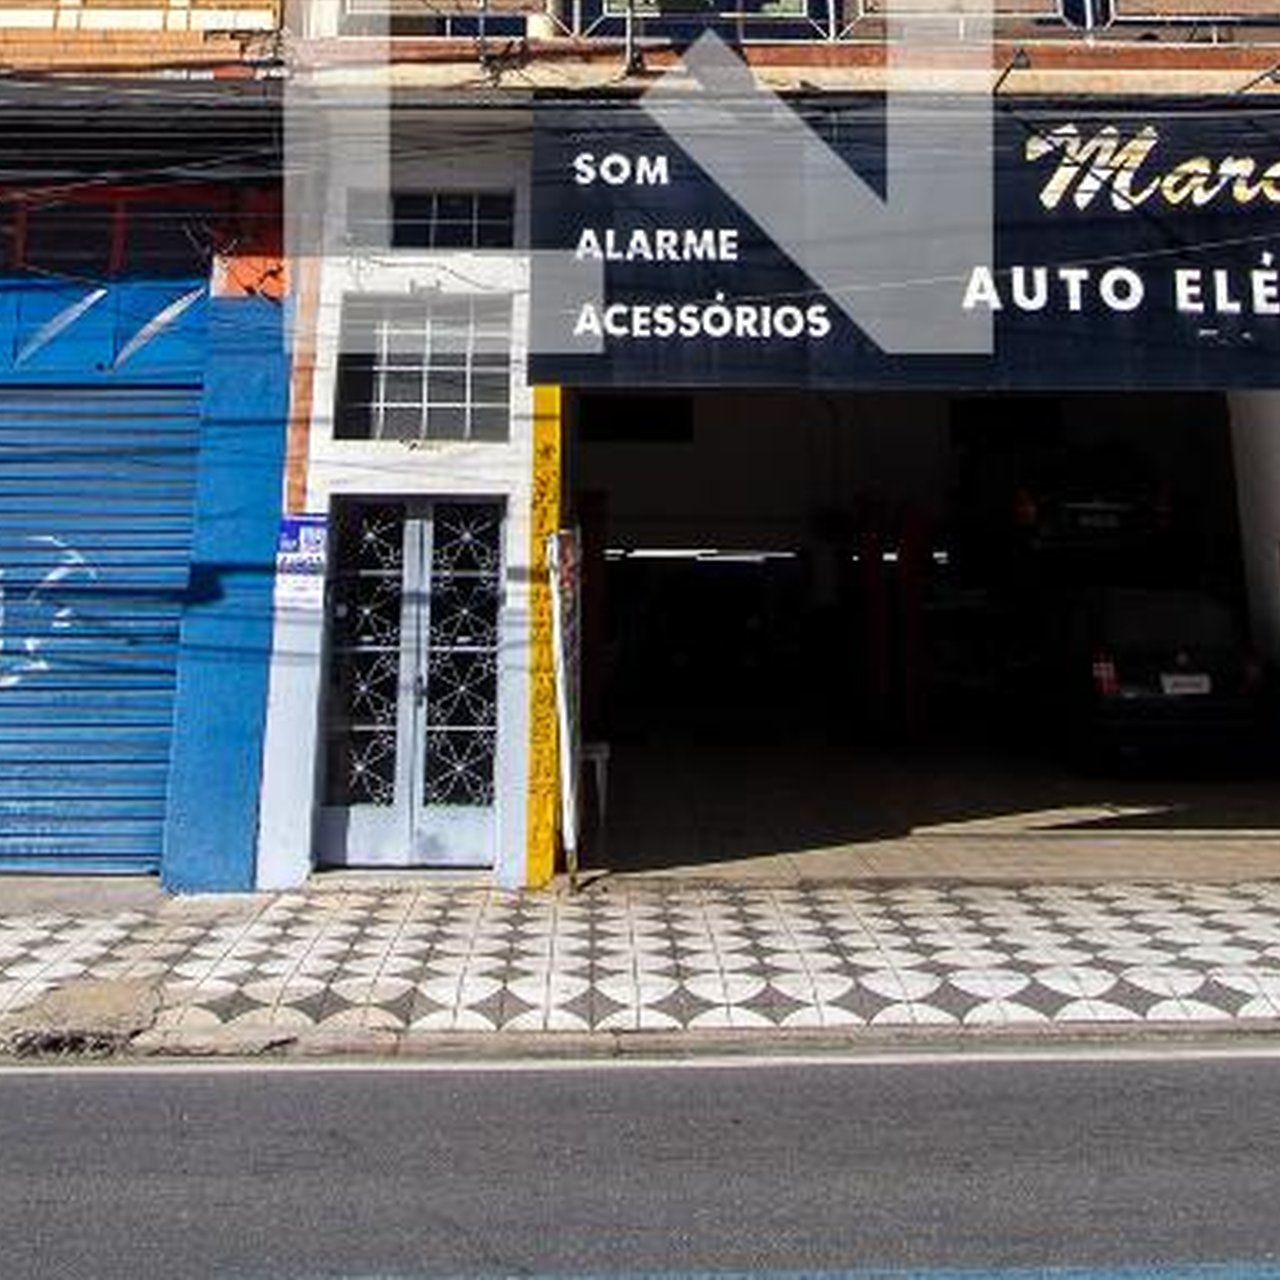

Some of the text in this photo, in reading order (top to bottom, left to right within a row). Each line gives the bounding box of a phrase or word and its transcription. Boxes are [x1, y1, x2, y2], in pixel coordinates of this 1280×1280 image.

[574, 153, 670, 186] SOM
[575, 228, 739, 262] ALARME
[962, 265, 1145, 313] AUTO
[574, 293, 833, 339] ACESSÓRIOS
